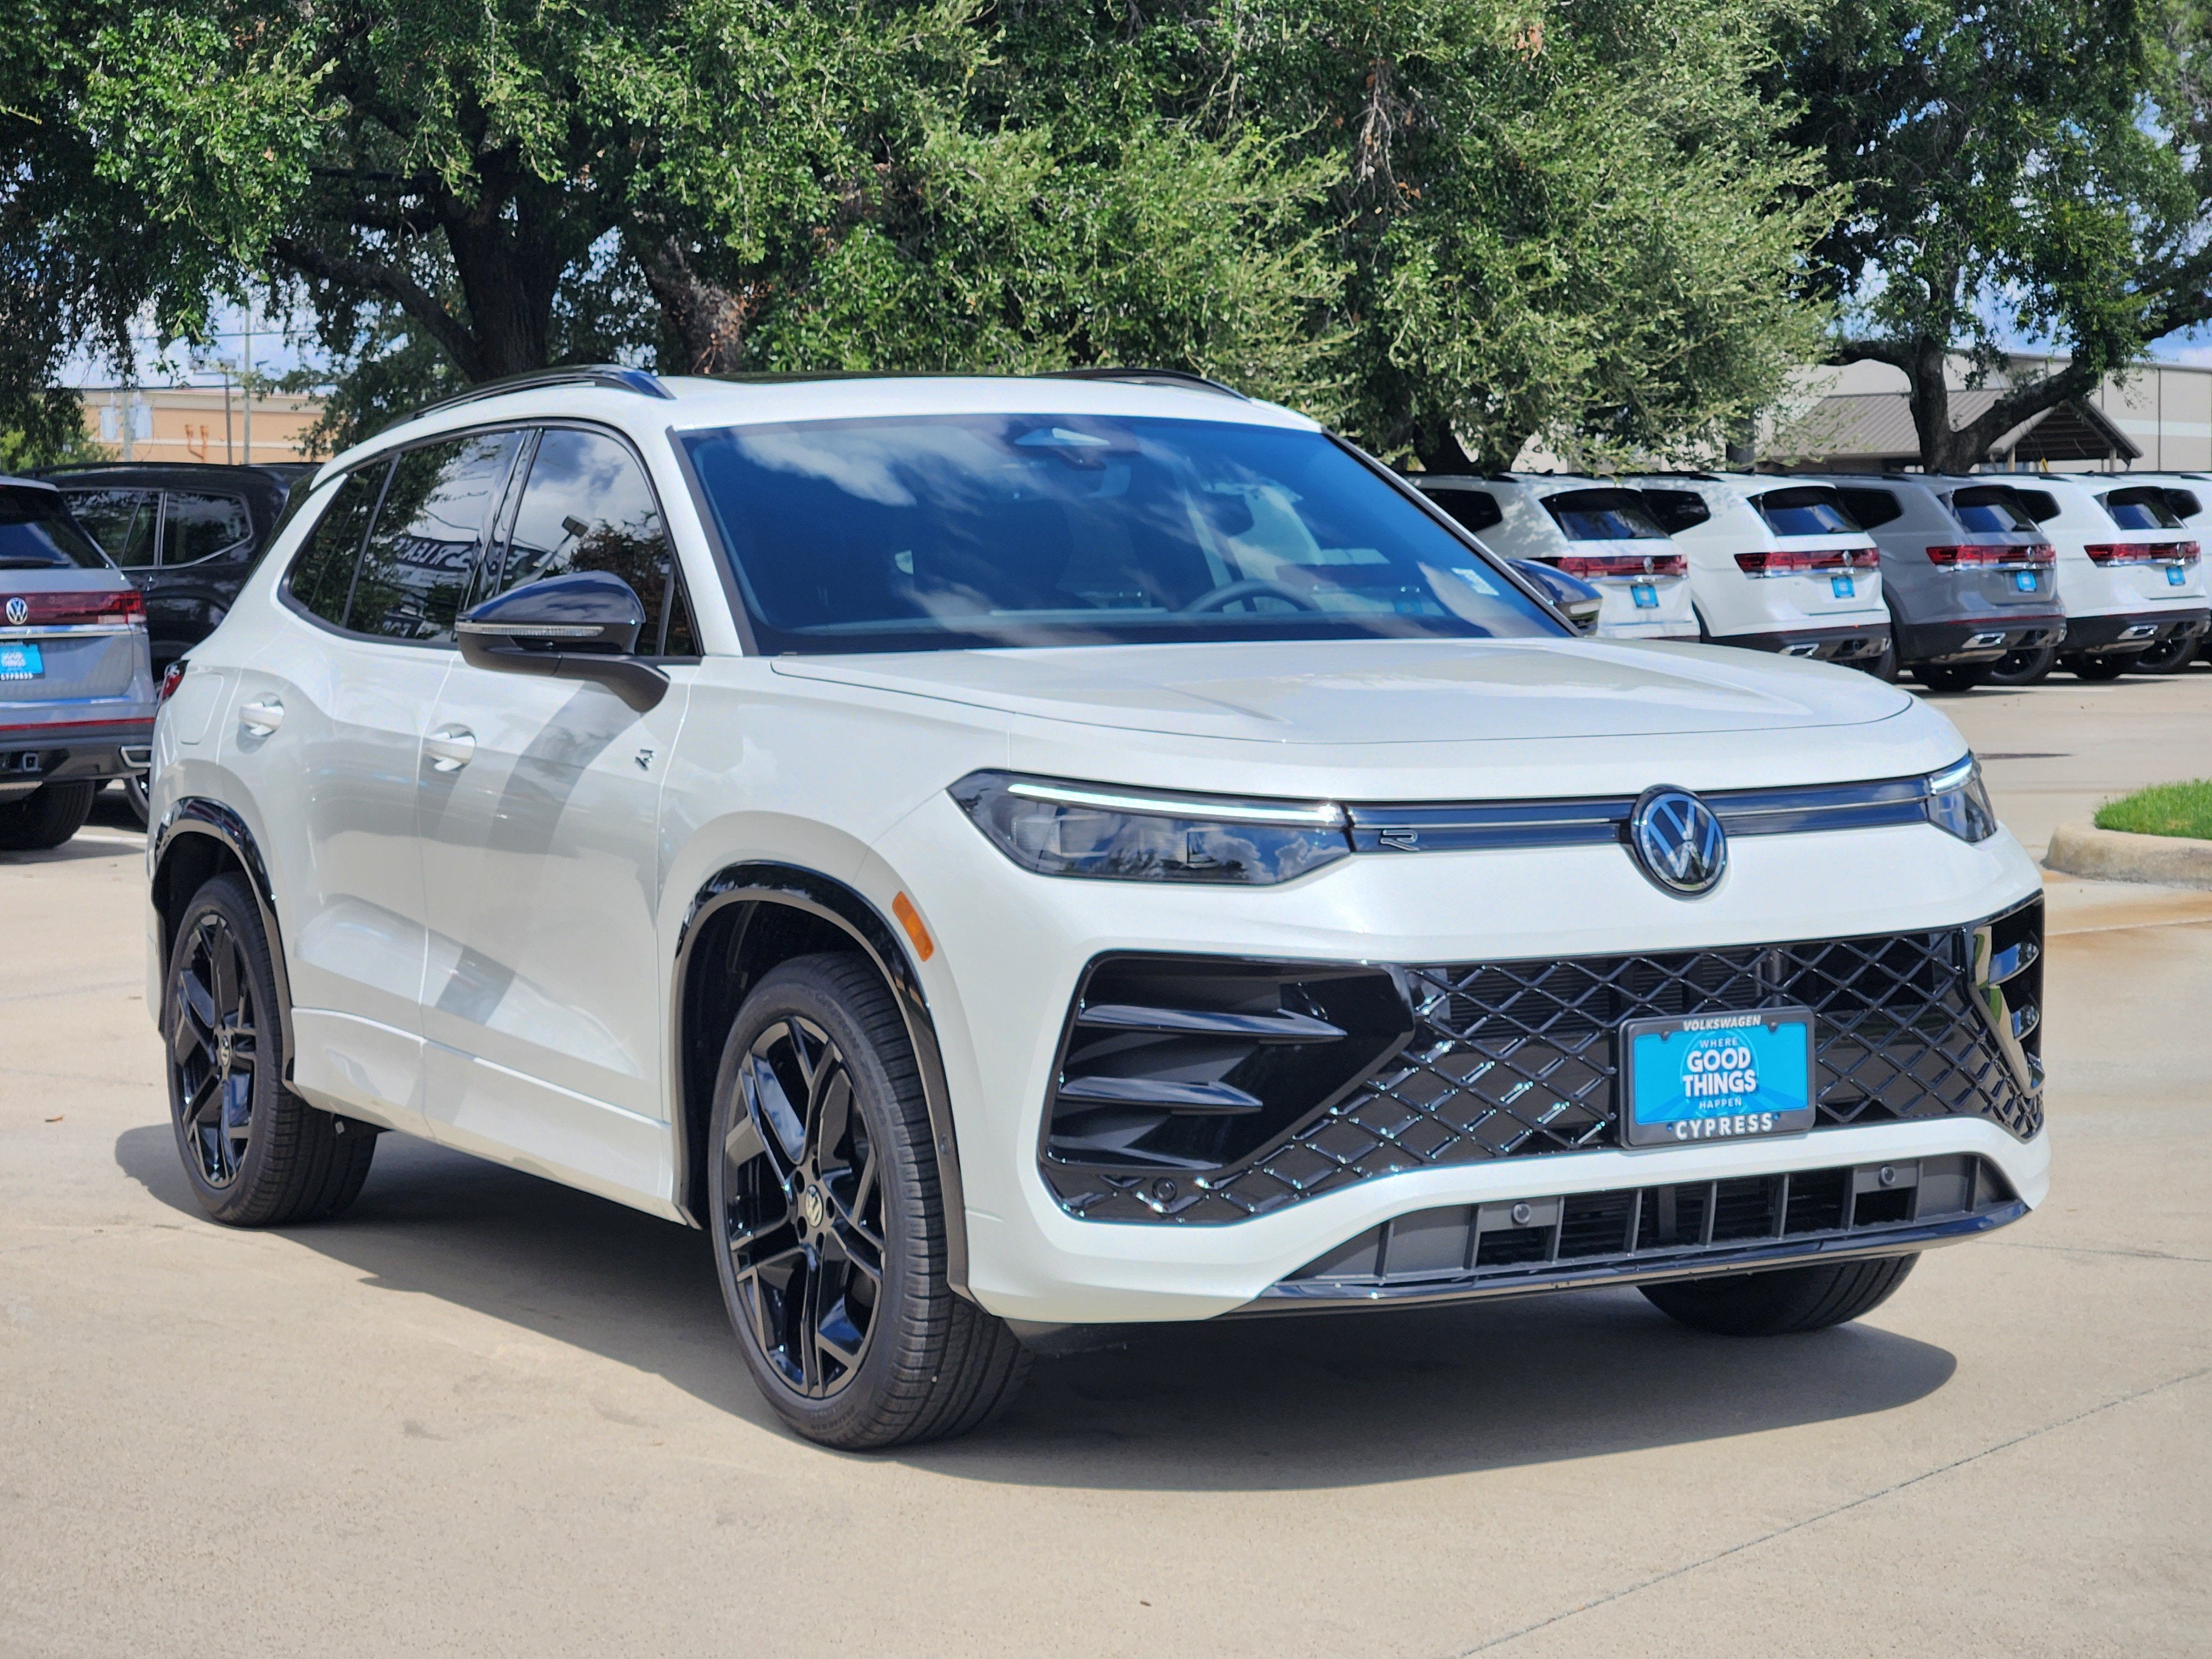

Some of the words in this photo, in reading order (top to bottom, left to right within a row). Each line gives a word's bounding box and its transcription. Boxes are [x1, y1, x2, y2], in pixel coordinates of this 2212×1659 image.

[1380, 829, 1419, 851] R
[1642, 795, 1723, 887] VW
[1683, 1015, 1762, 1032] VOLKSWAGEN
[1699, 1037, 1738, 1049] WHERE
[1686, 1047, 1752, 1073] GOOD
[1682, 1069, 1757, 1098] THINGS
[1698, 1097, 1742, 1110] HAPPEN
[1675, 1112, 1773, 1140] CYPRESS
